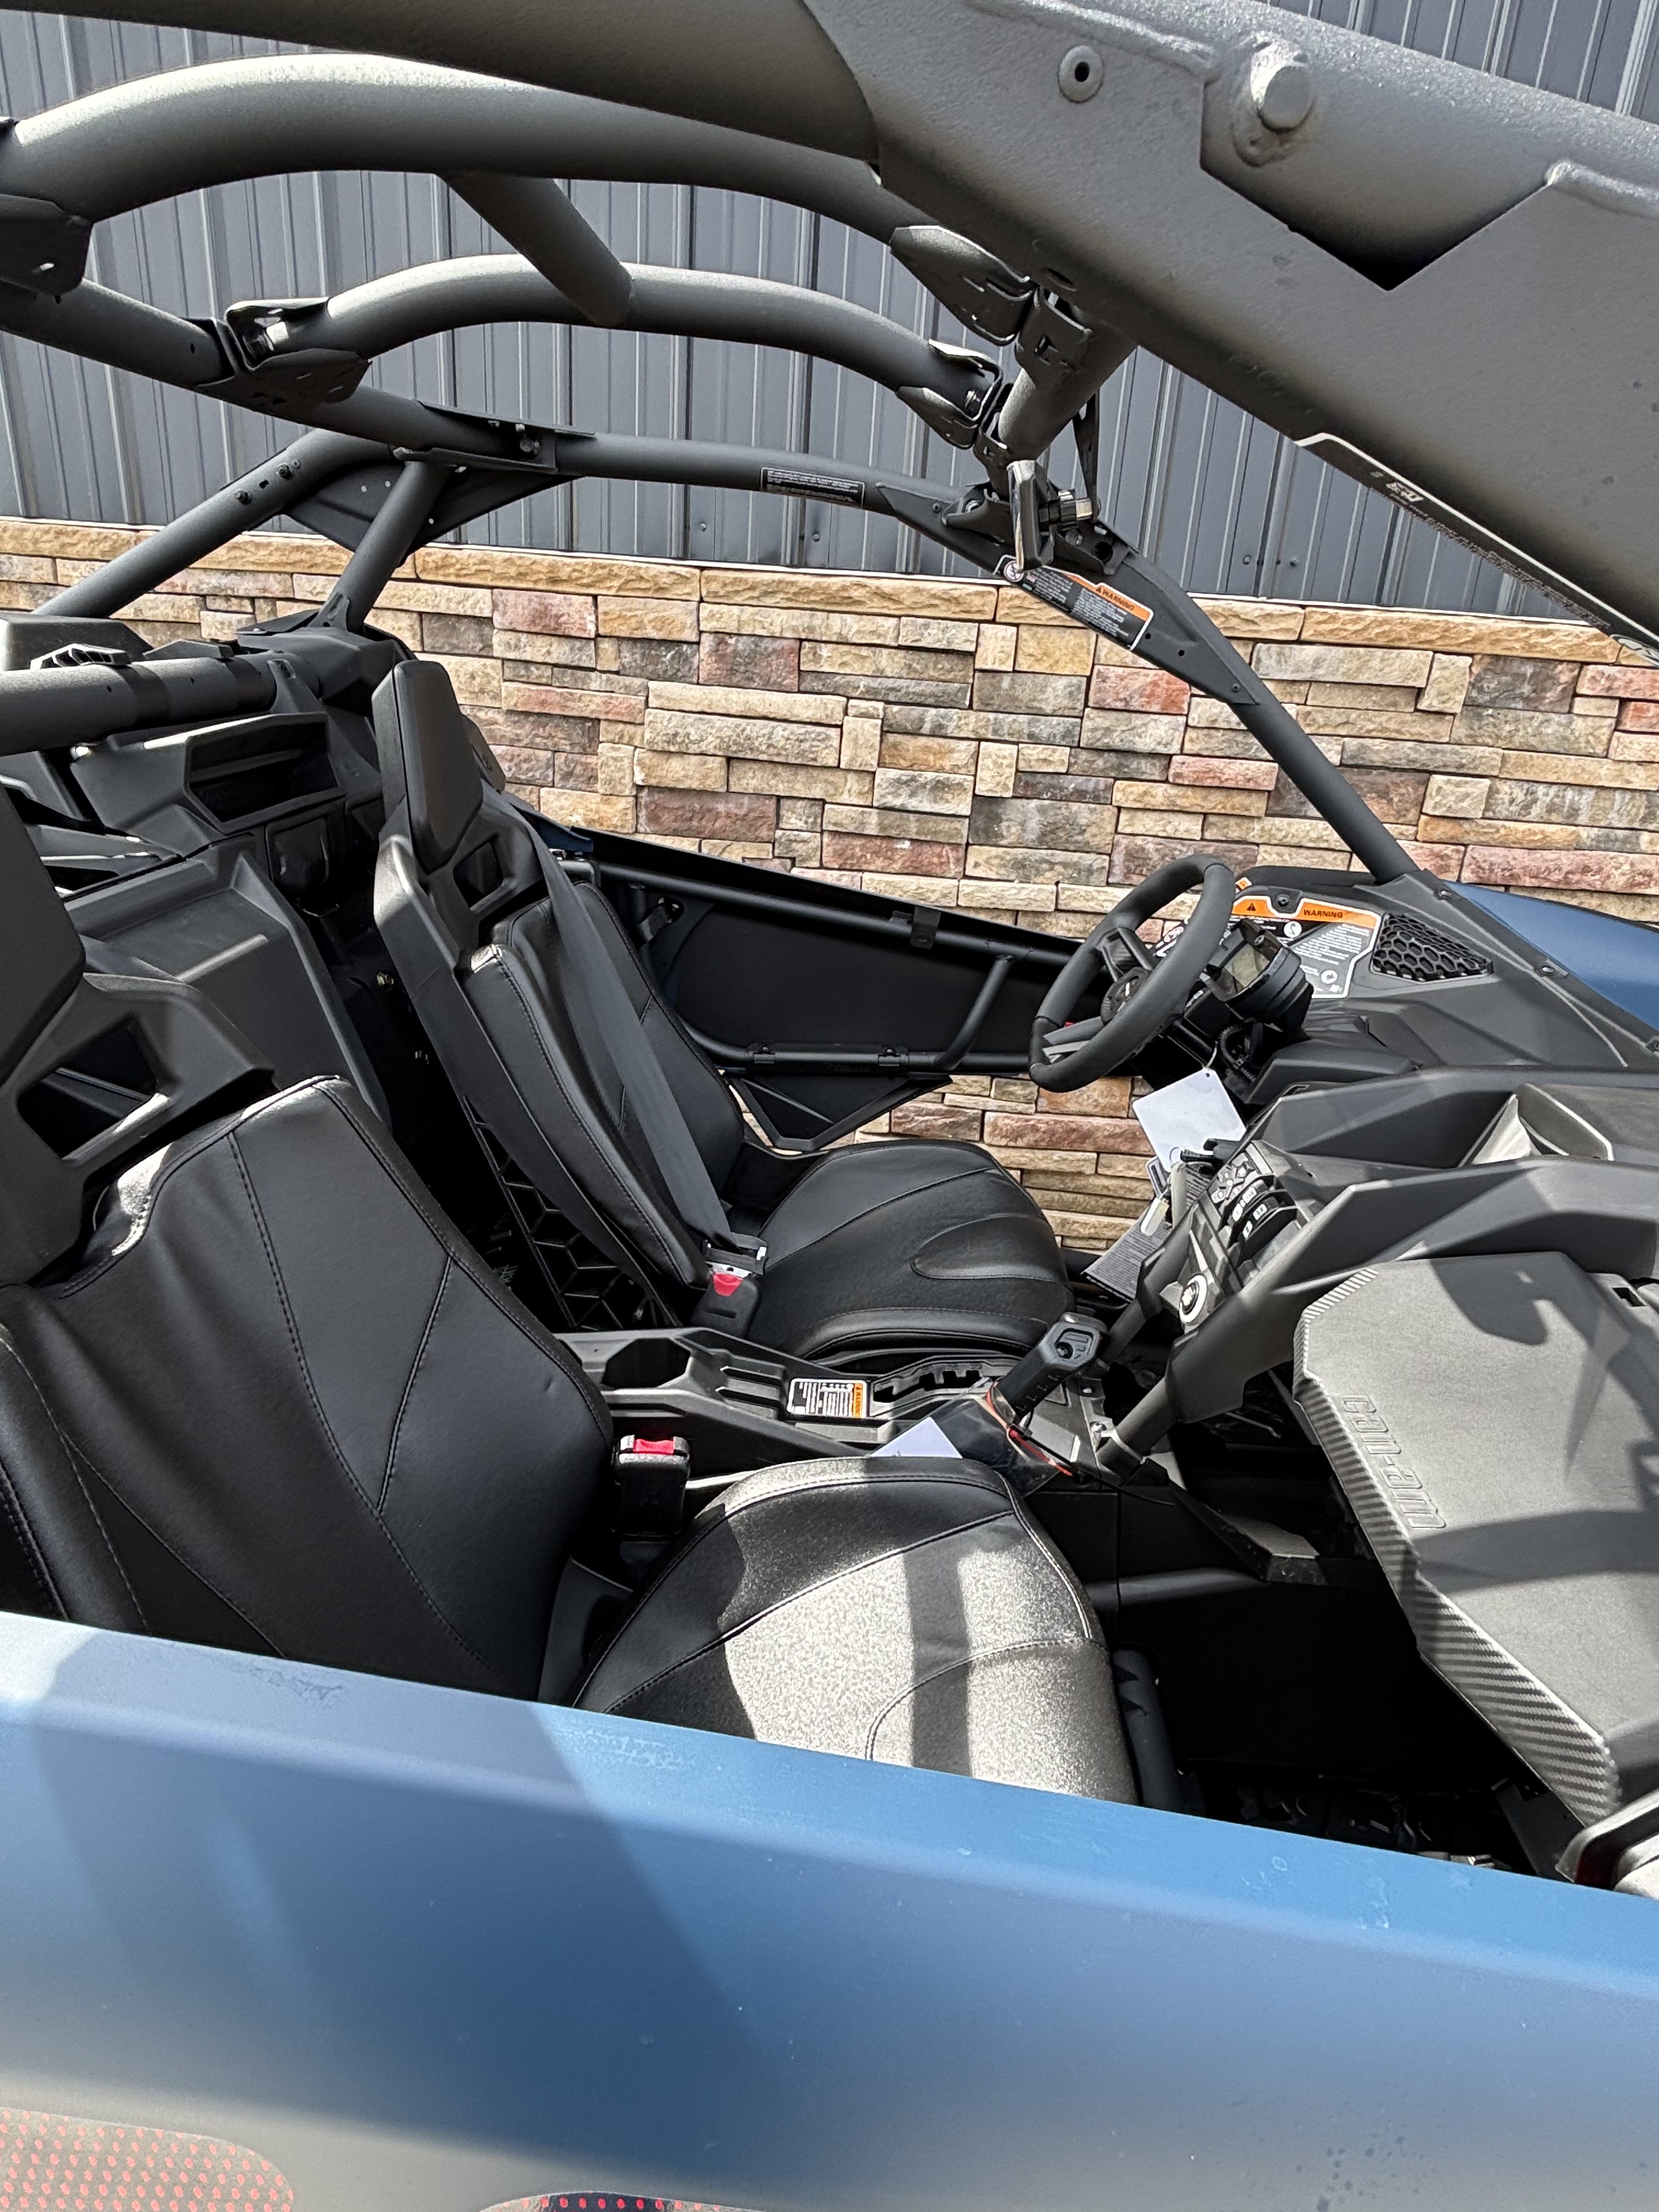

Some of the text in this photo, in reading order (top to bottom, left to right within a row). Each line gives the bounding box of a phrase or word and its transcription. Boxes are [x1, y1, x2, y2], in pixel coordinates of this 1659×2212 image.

[1101, 588, 1135, 611] WARNING
[1303, 909, 1344, 918] WARNING
[1339, 1394, 1446, 1528] CAN-AM
